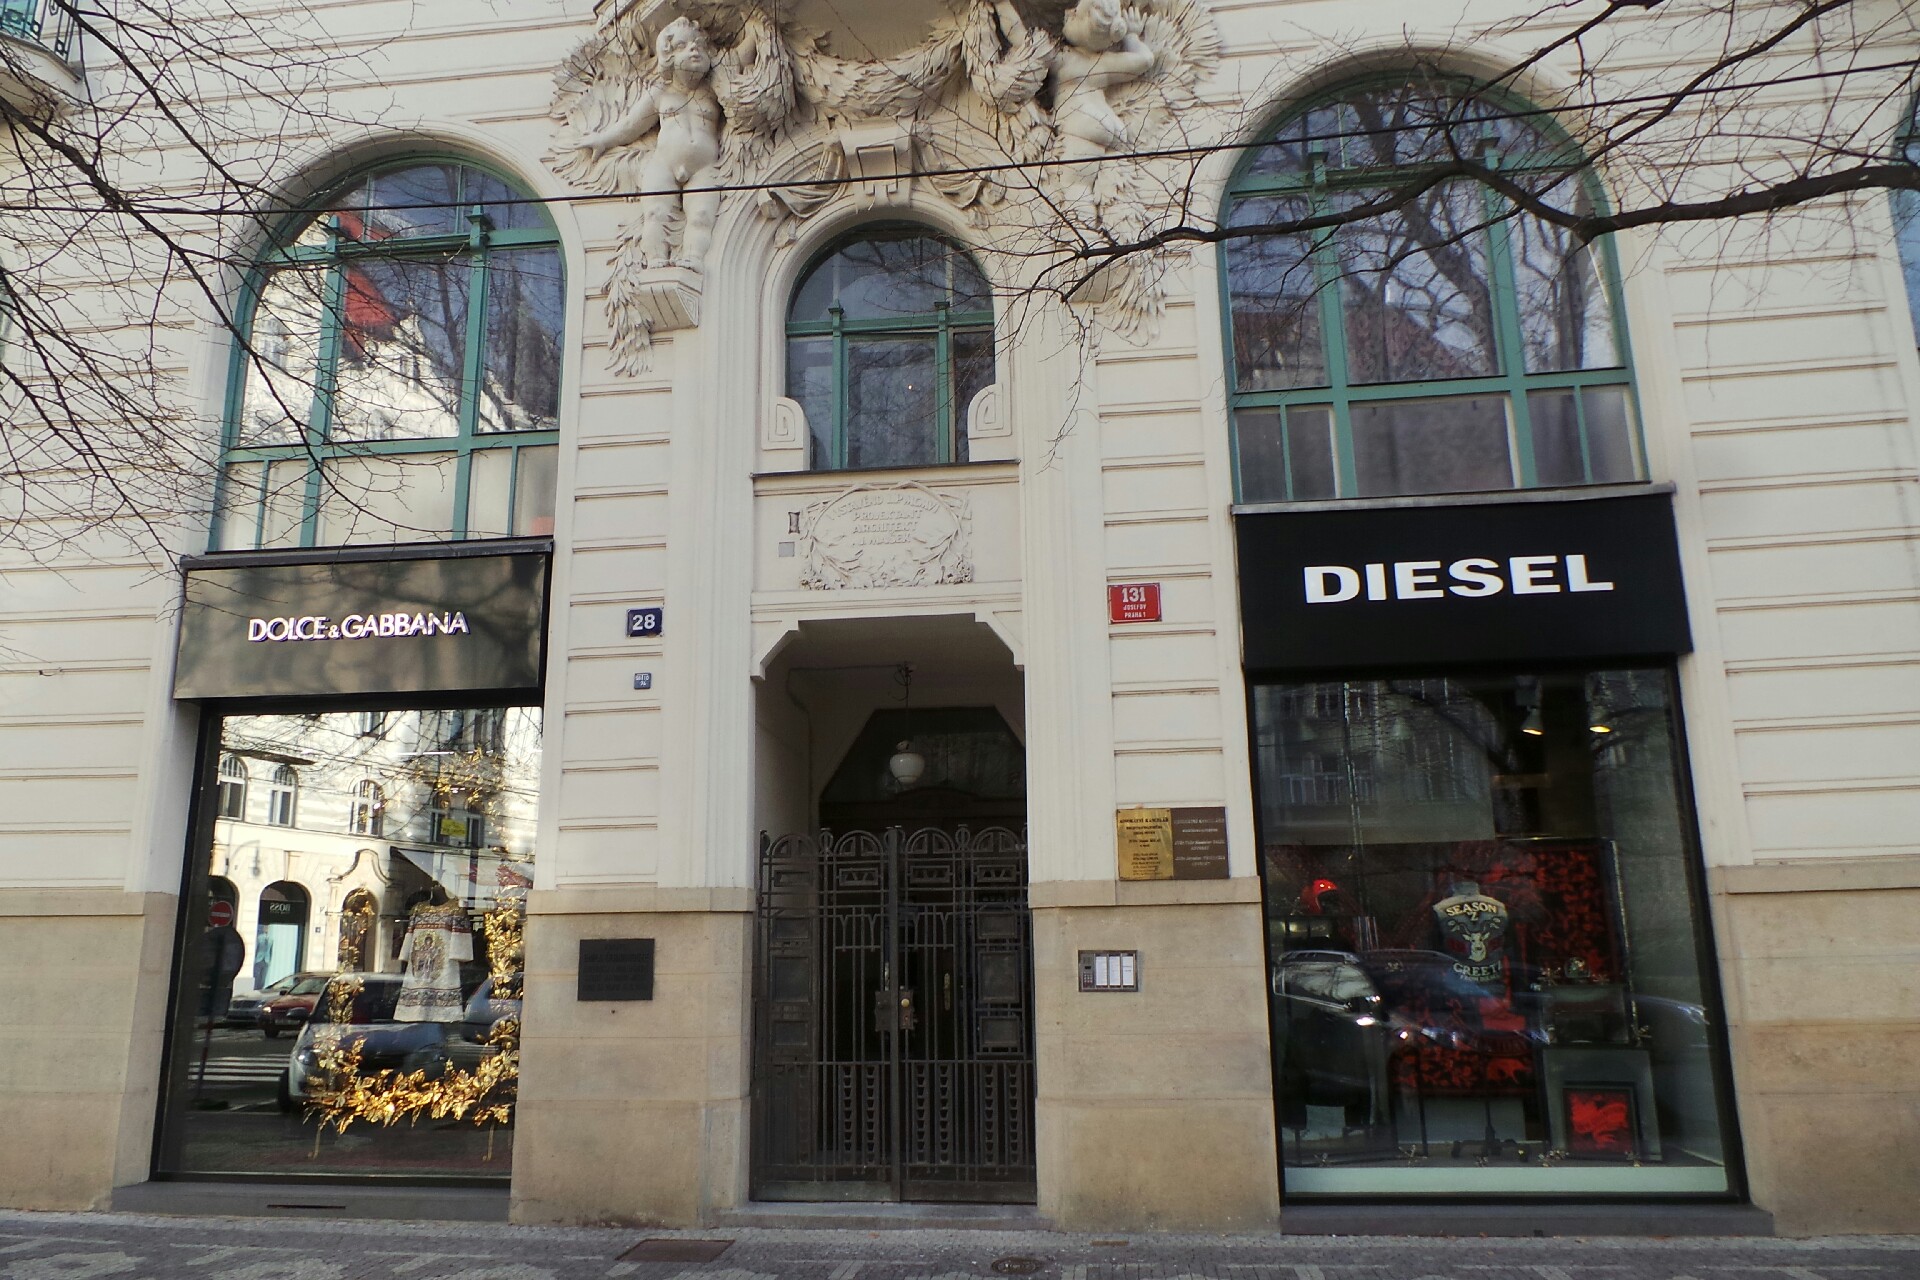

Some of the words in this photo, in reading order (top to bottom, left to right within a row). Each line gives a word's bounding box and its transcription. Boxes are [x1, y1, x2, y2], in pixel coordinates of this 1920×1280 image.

[1304, 554, 1614, 603] DIESEL
[1122, 587, 1146, 603] 131
[632, 614, 655, 630] 28
[1446, 901, 1497, 917] SEASON
